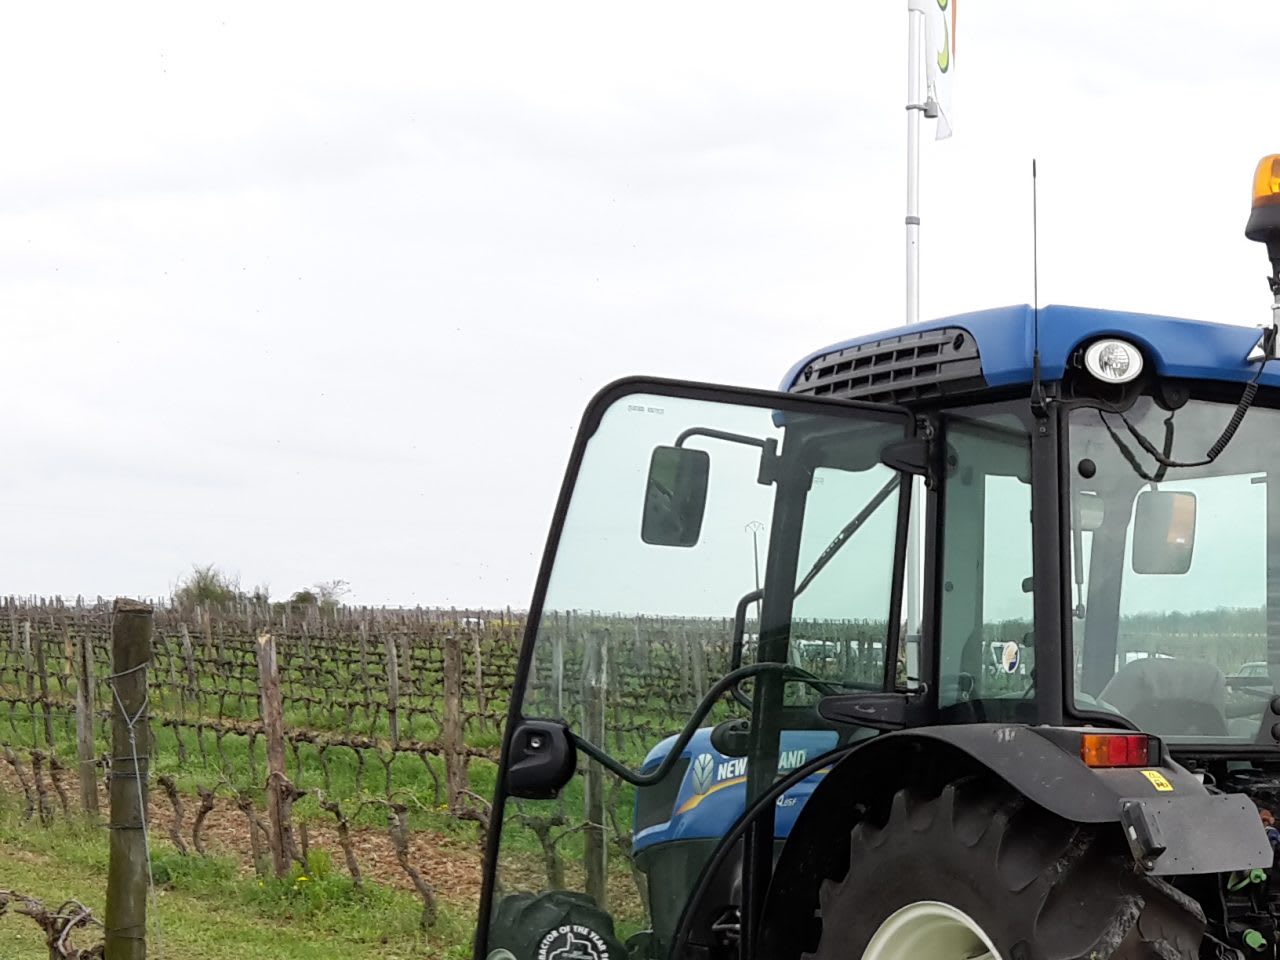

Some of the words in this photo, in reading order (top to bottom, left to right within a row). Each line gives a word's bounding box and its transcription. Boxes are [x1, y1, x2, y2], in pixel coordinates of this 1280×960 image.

[717, 756, 748, 781] NEW
[559, 925, 571, 935] OF
[572, 925, 591, 936] THE
